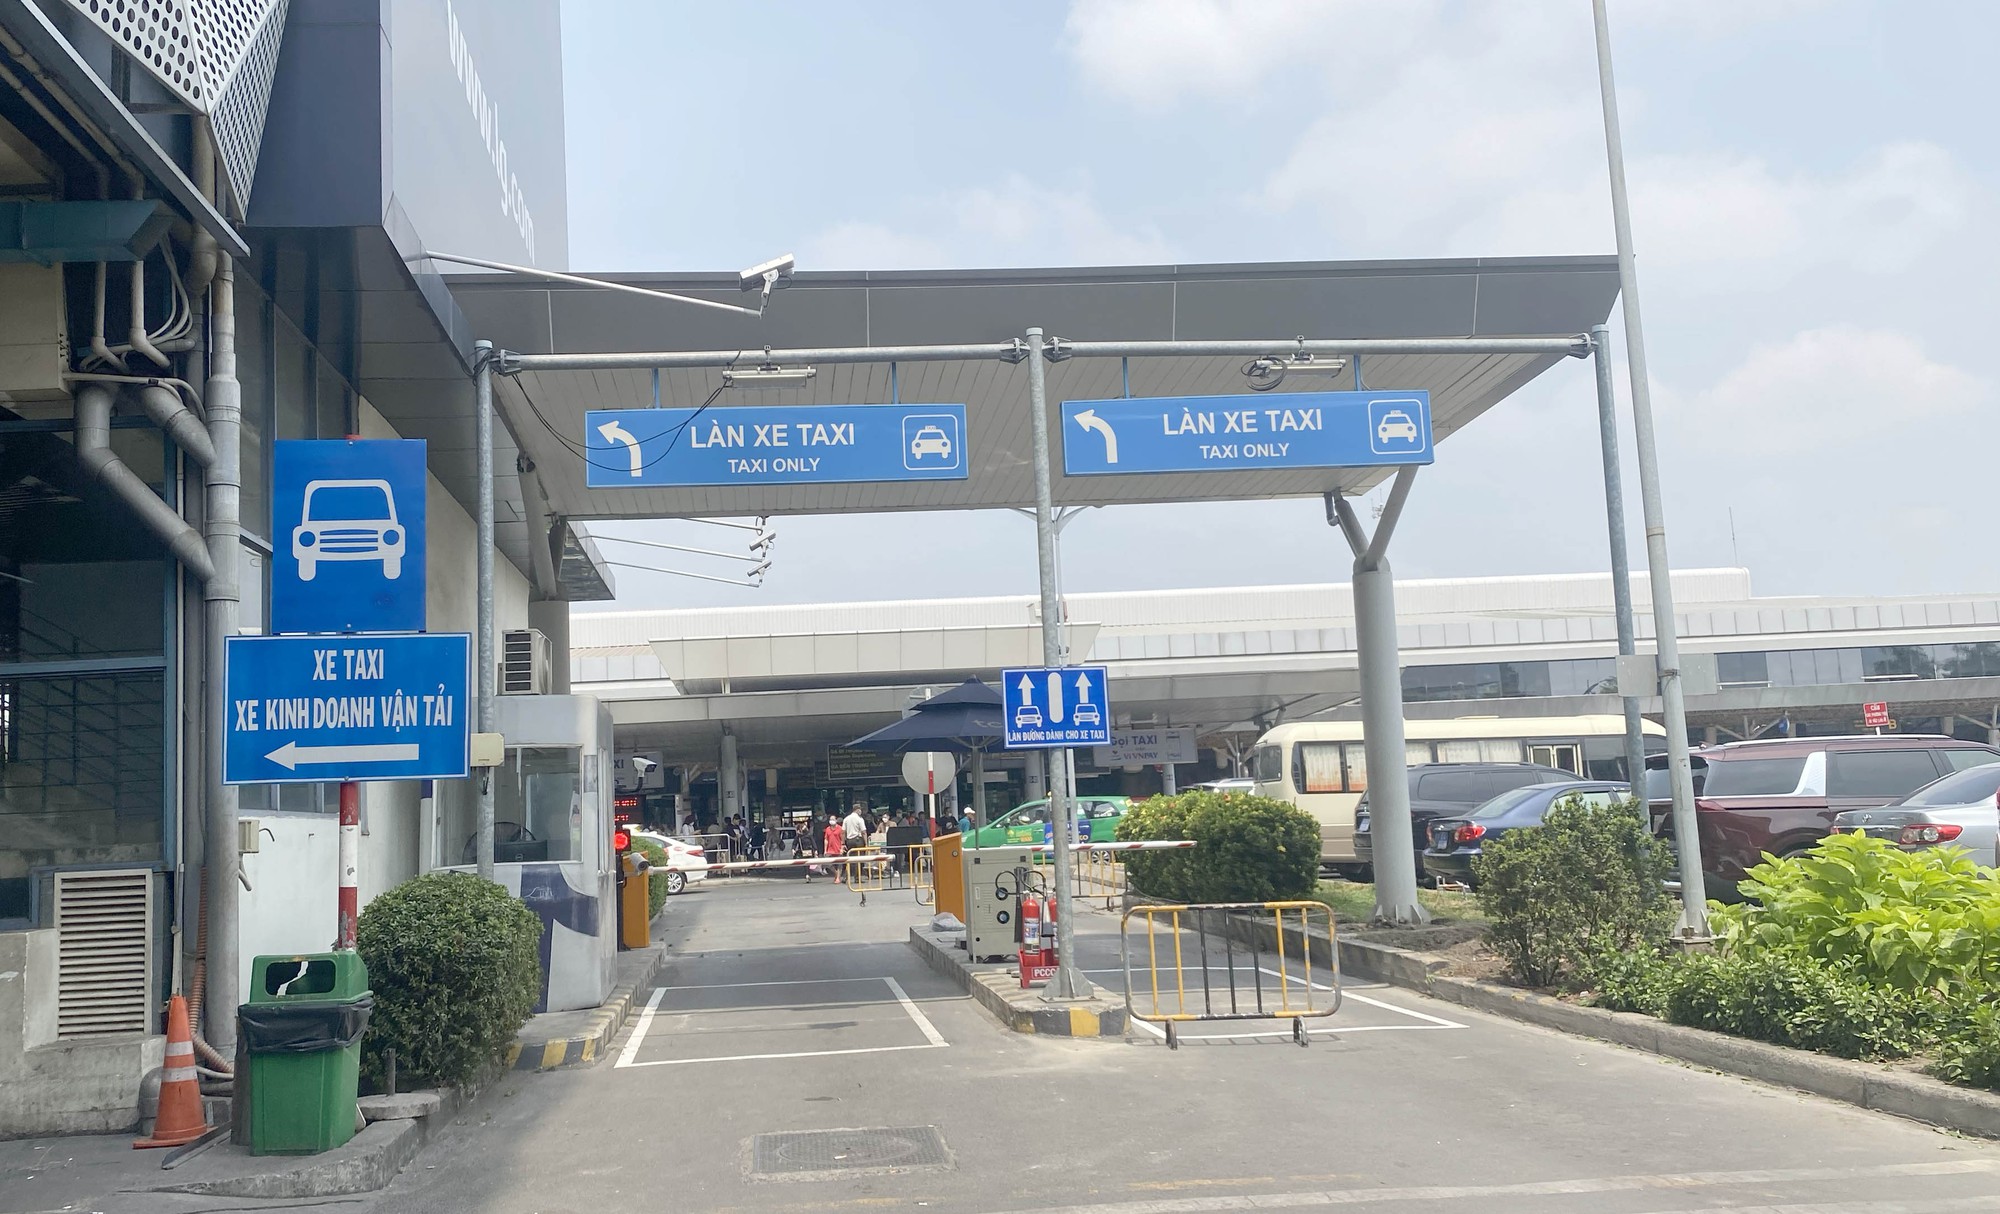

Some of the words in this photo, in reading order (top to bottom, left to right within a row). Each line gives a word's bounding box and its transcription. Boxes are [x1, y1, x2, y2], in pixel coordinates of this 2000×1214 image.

[446, 0, 536, 266] www.lg.com
[691, 419, 744, 449] LÀN
[753, 424, 788, 447] XE
[796, 422, 855, 446] TAXI
[1163, 407, 1215, 435] LÀN
[1223, 411, 1257, 434] XE
[1265, 408, 1322, 432] TAXI
[728, 459, 767, 474] TAXI
[773, 457, 820, 473] ONLY
[1200, 445, 1238, 460] TAXI
[1243, 443, 1290, 458] ONLY
[312, 649, 337, 681] XE
[343, 648, 384, 680] TAXI
[235, 699, 259, 732] XE
[265, 697, 310, 730] KINH
[313, 696, 375, 729] DOANH
[381, 688, 418, 733] VẬN
[422, 683, 453, 727] TẢI
[1046, 729, 1064, 740] DÀNH
[1065, 730, 1078, 740] CHO
[1080, 730, 1089, 739] XE
[1090, 730, 1105, 740] TAXI
[1131, 735, 1157, 745] TAXI
